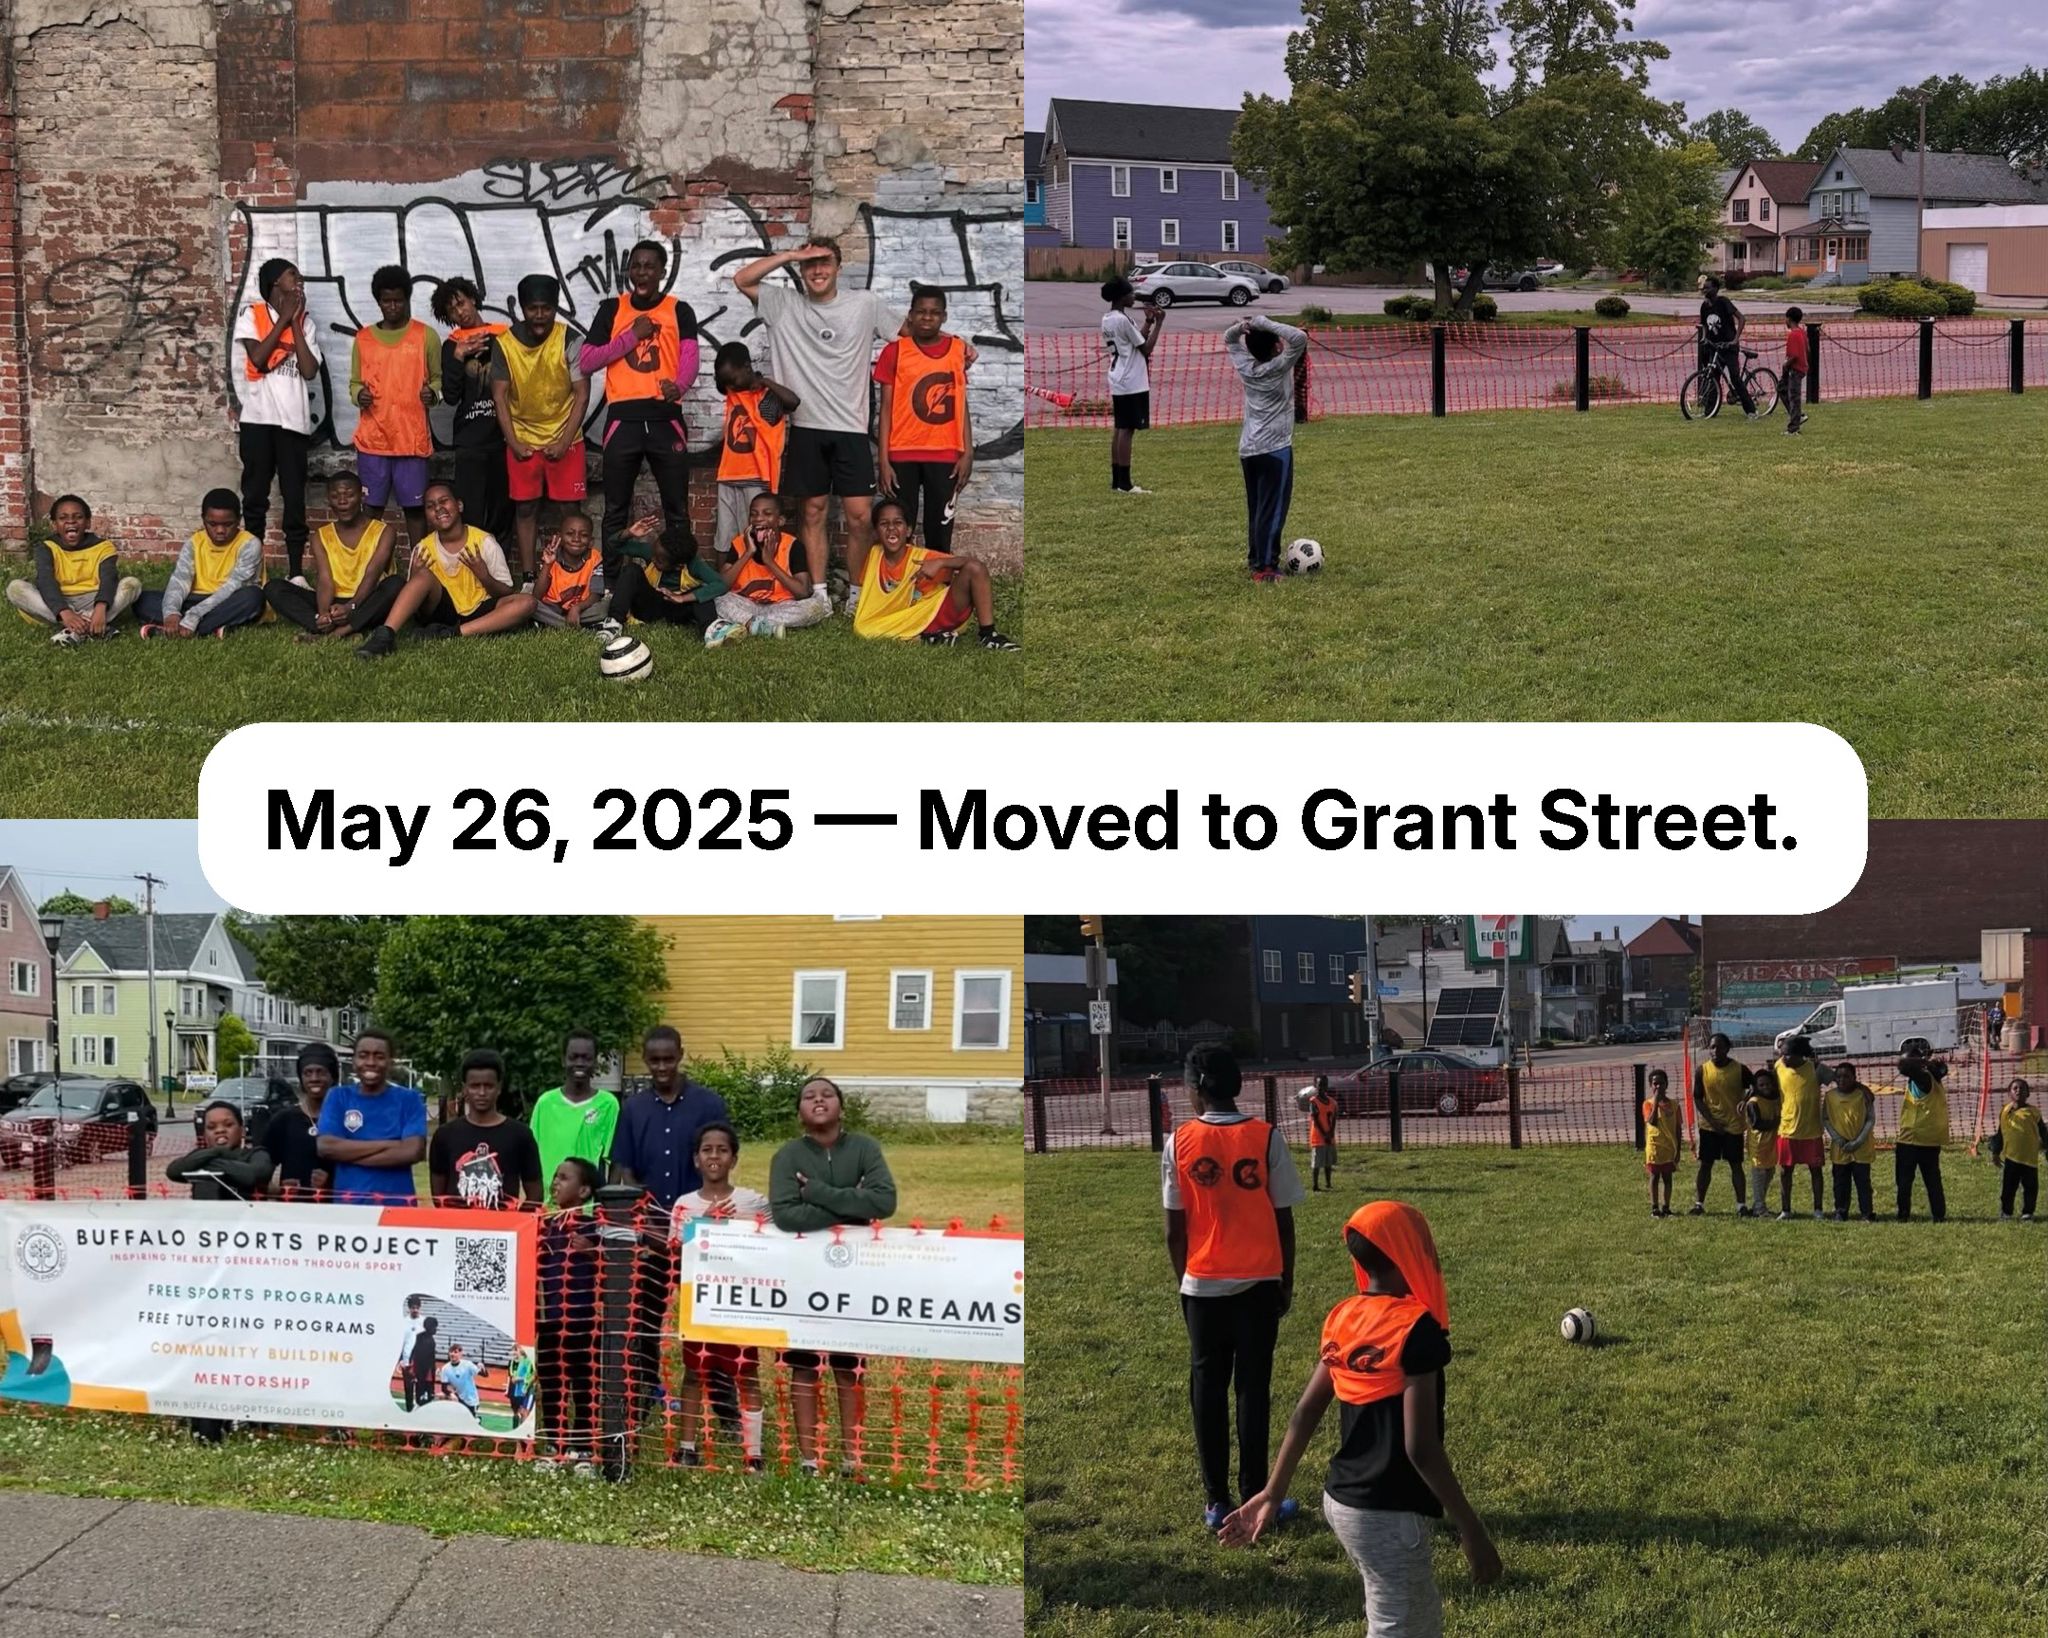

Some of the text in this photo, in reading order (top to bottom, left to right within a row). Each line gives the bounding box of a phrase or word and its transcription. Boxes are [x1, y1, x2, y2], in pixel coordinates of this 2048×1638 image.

[912, 371, 956, 425] G
[727, 404, 756, 454] G
[1481, 931, 1518, 941] ELEVn
[1092, 1003, 1107, 1011] ONE
[77, 1229, 439, 1257] BUFFALO SPORTS PROJECT
[110, 1252, 403, 1271] INSPIRING THE NEXT GENERATION THROUGH SPORT
[696, 1274, 786, 1287] GRANT STREET
[148, 1284, 365, 1306] FREE SPORTS PROGRAMS
[696, 1283, 1022, 1324] FIELD OF DREAMS
[138, 1311, 376, 1335] FREE TUTORING PROGRAMS
[151, 1341, 354, 1364] COMMUNITY BUILDING
[195, 1372, 311, 1390] MENTORSHIP
[154, 1399, 345, 1418] WWW.BUFFALOSPORTSPROJECT.ORG
